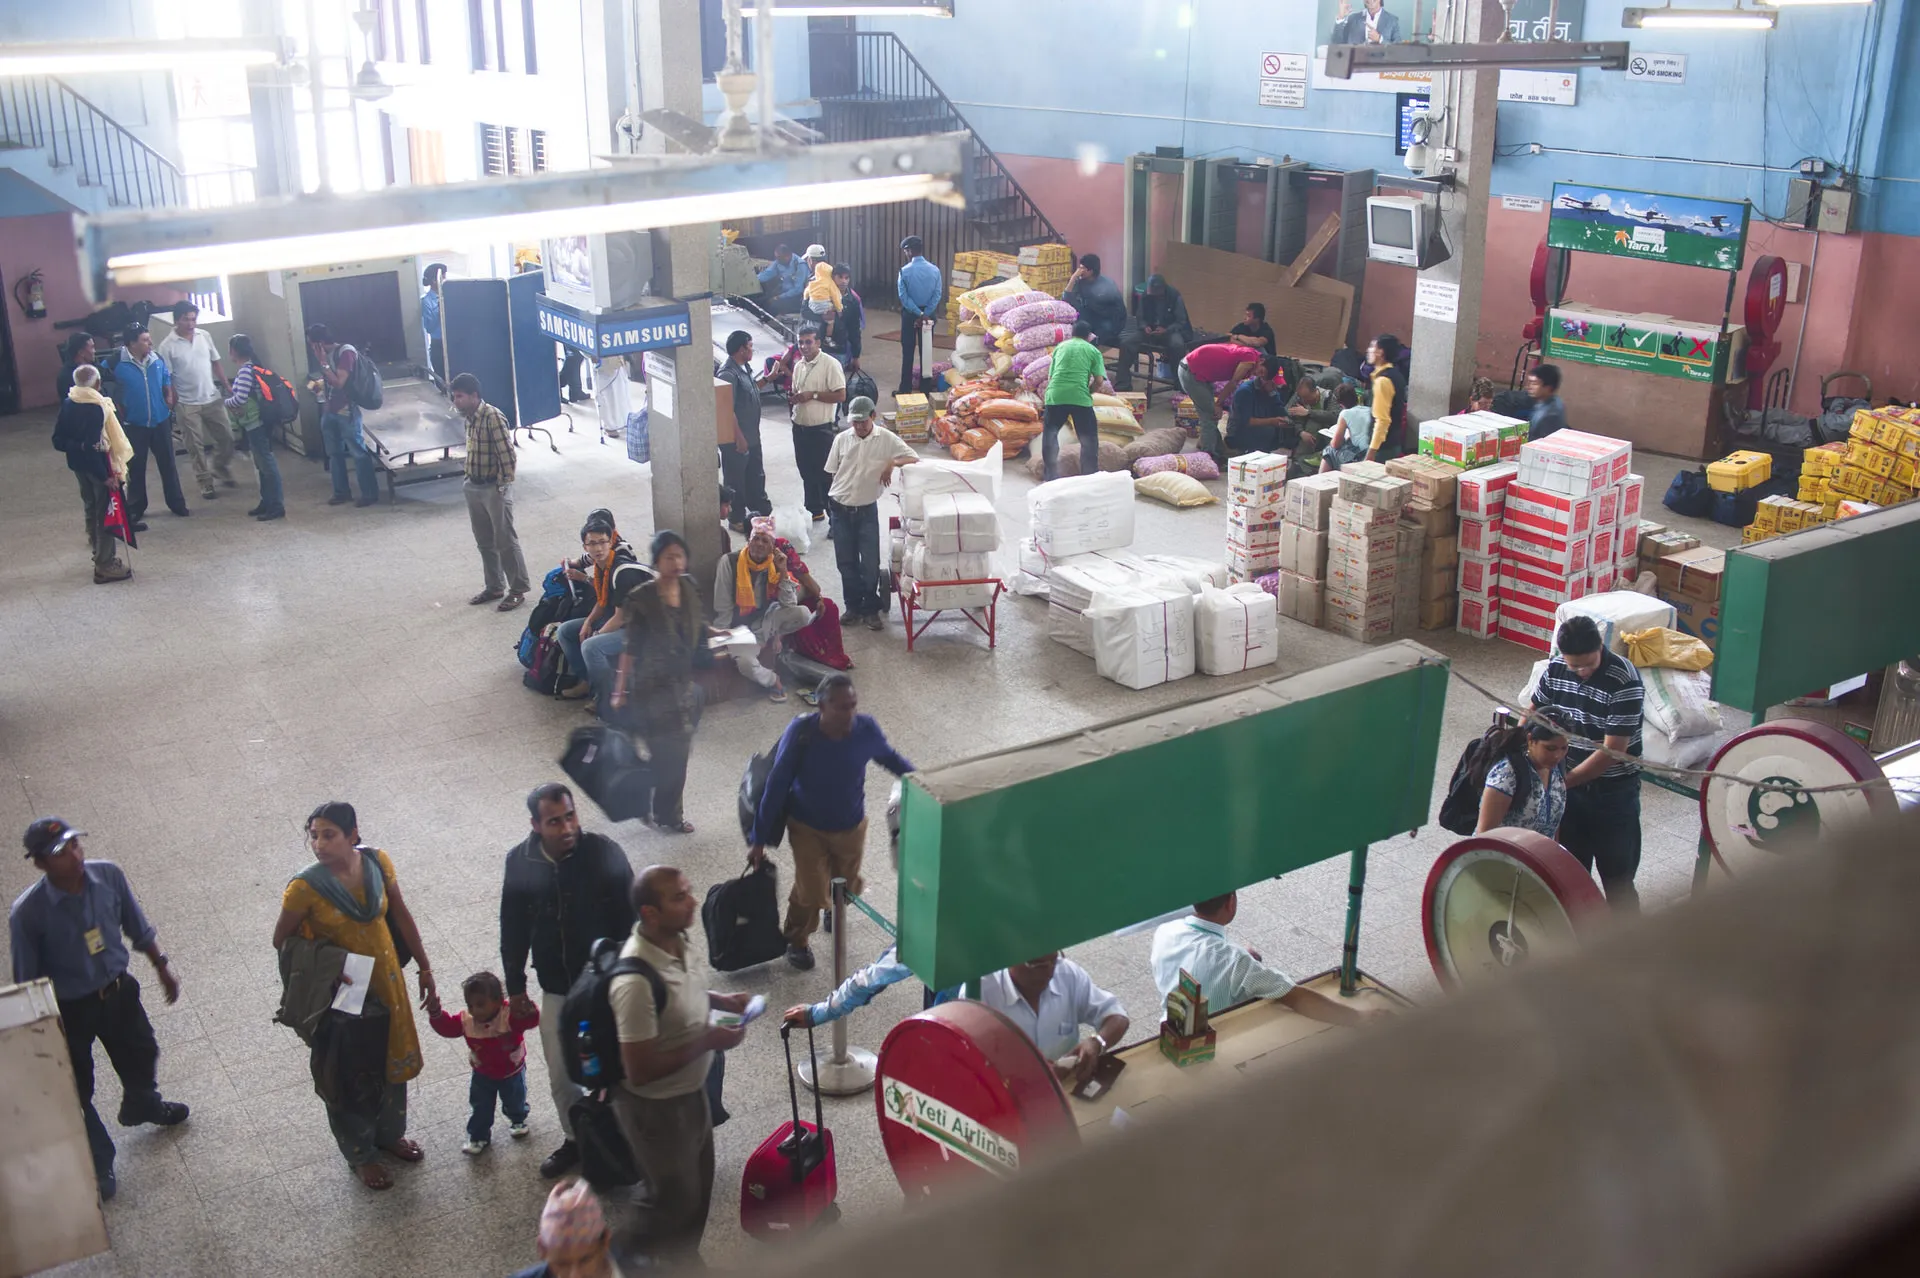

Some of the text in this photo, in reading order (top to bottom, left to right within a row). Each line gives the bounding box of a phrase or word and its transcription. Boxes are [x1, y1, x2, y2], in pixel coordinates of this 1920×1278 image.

[1656, 70, 1682, 78] SMOKING
[1628, 240, 1650, 252] Tara
[1651, 244, 1668, 254] Air
[539, 311, 594, 349] SAMSUNG
[601, 322, 688, 348] SAMSUNG
[915, 1095, 1017, 1168] Yeti Airlines
